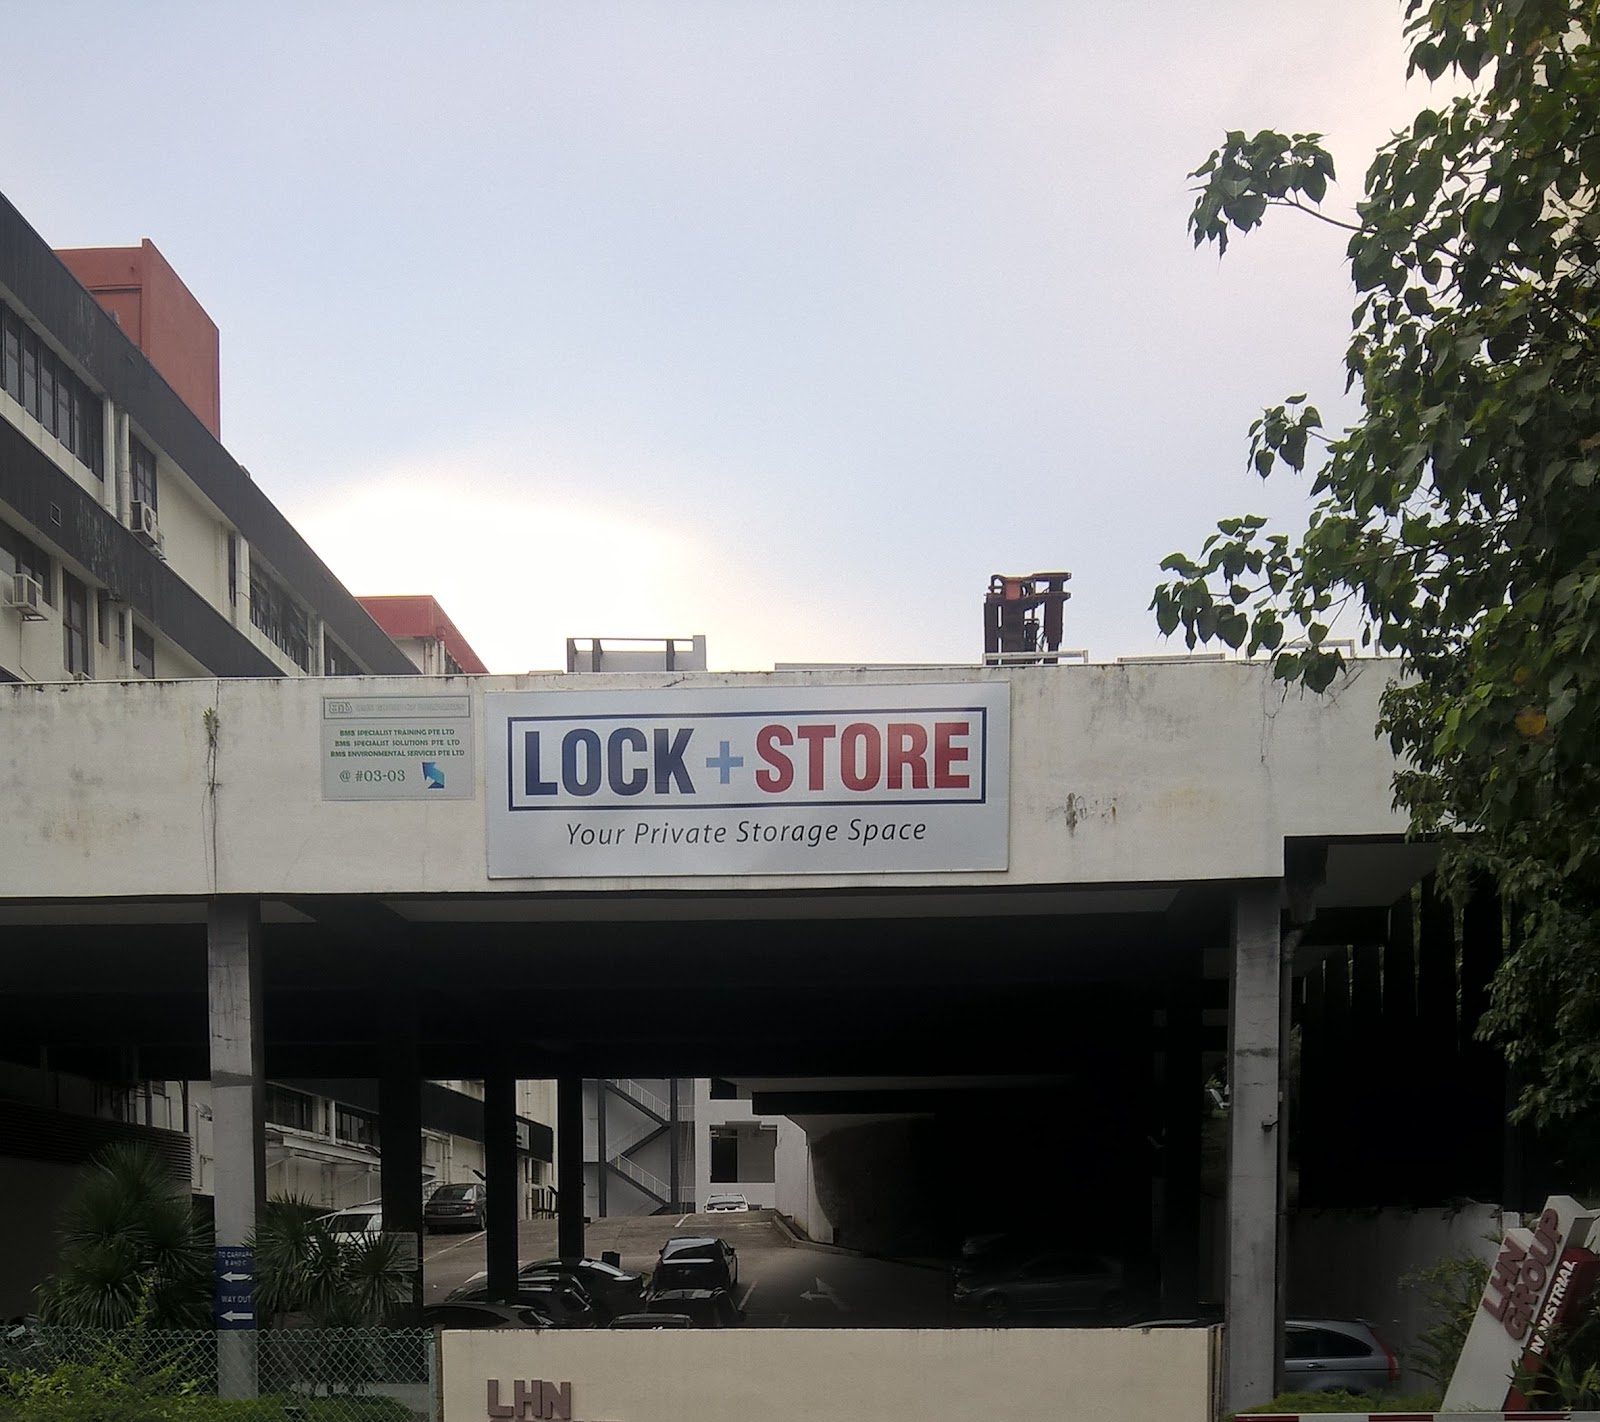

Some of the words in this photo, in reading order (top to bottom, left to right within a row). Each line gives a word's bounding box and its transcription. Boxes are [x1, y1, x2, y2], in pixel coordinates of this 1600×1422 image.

[442, 728, 455, 736] LTD
[330, 750, 346, 758] BMS
[452, 749, 465, 757] LTD
[524, 727, 696, 797] LOCK
[755, 722, 971, 794] STORE
[355, 769, 406, 783] #03-03
[567, 822, 625, 846] Your
[635, 820, 727, 845] Private
[737, 819, 839, 848] Storage
[848, 818, 927, 847] Space
[1481, 1236, 1527, 1323] LHN
[1502, 1208, 1563, 1341] GROUP
[221, 1295, 236, 1303] WAY
[237, 1295, 251, 1303] OUT
[1529, 1259, 1578, 1356] INUSTRIAL
[487, 1379, 572, 1421] LHN
